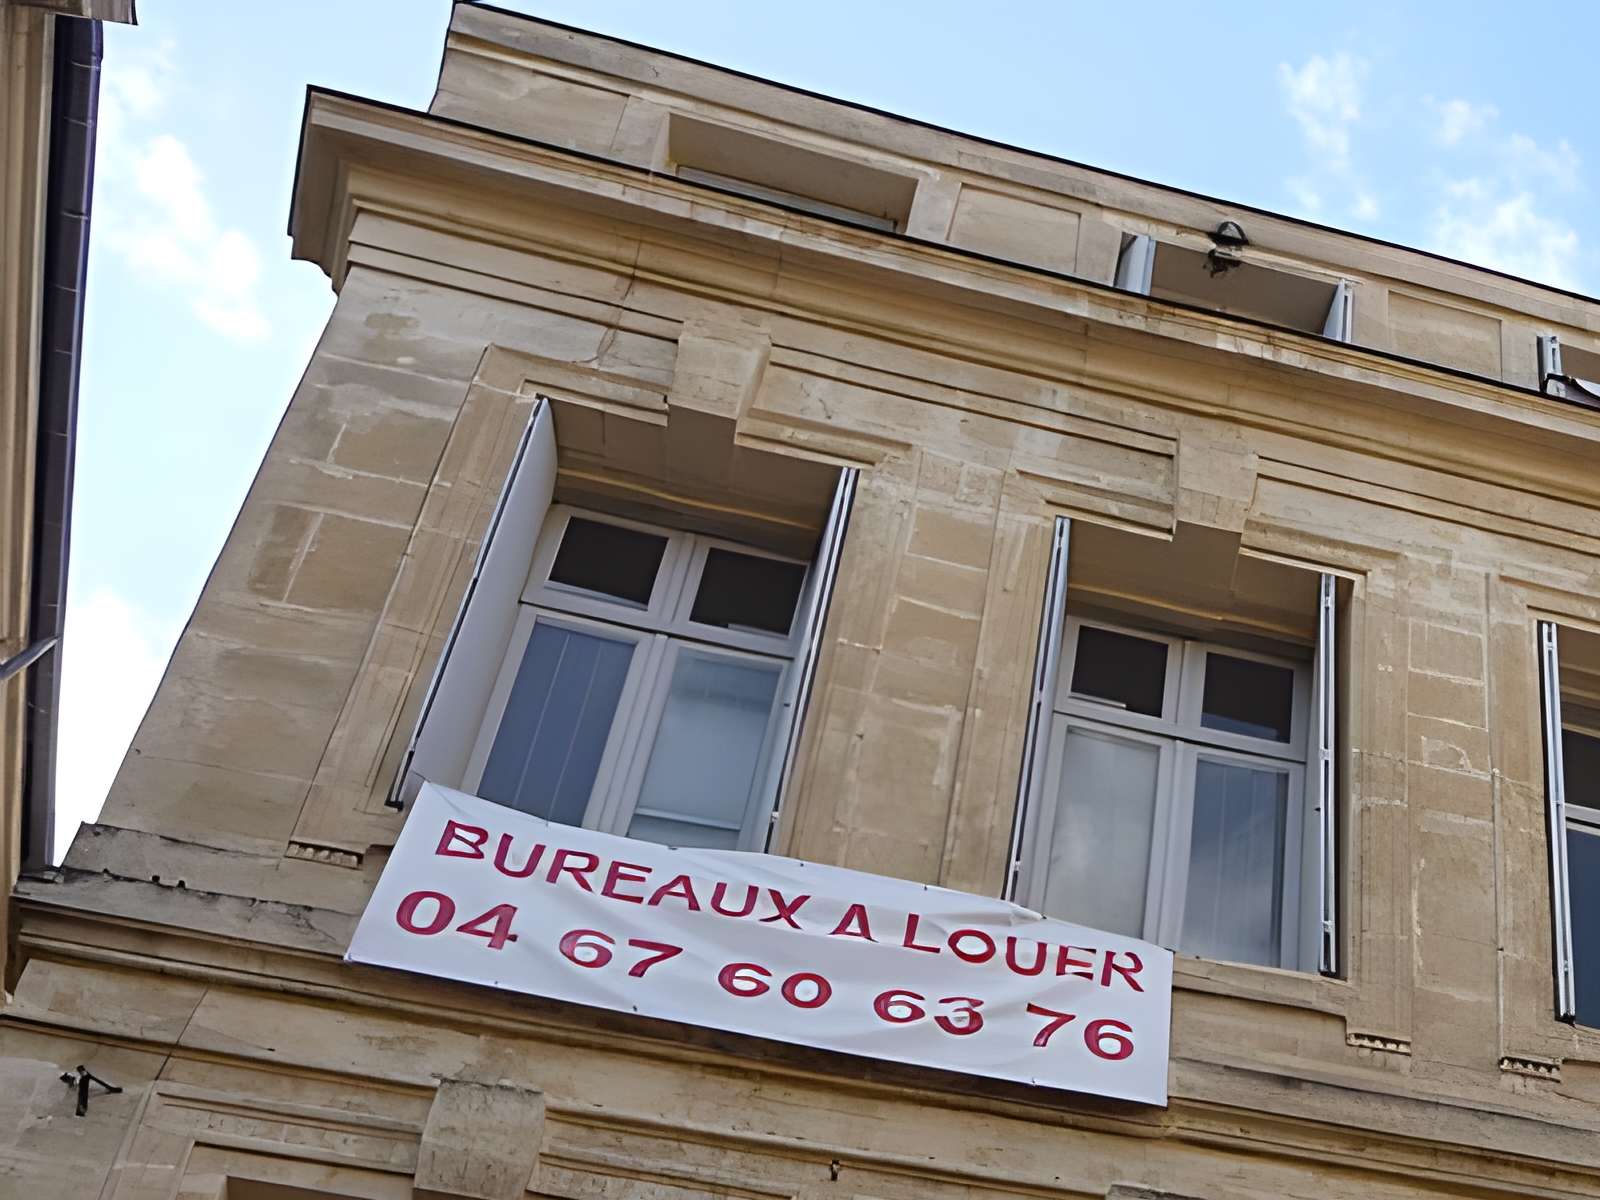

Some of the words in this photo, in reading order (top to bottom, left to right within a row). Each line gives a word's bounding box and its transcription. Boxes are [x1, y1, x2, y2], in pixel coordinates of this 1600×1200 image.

[394, 889, 519, 951] 04
[558, 926, 684, 979] 67
[717, 961, 834, 1010] 60
[872, 987, 985, 1037] 63
[1025, 1001, 1136, 1062] 76
[435, 819, 812, 931] BUREAUX
[829, 903, 876, 943] A
[902, 912, 1146, 994] LOUER
